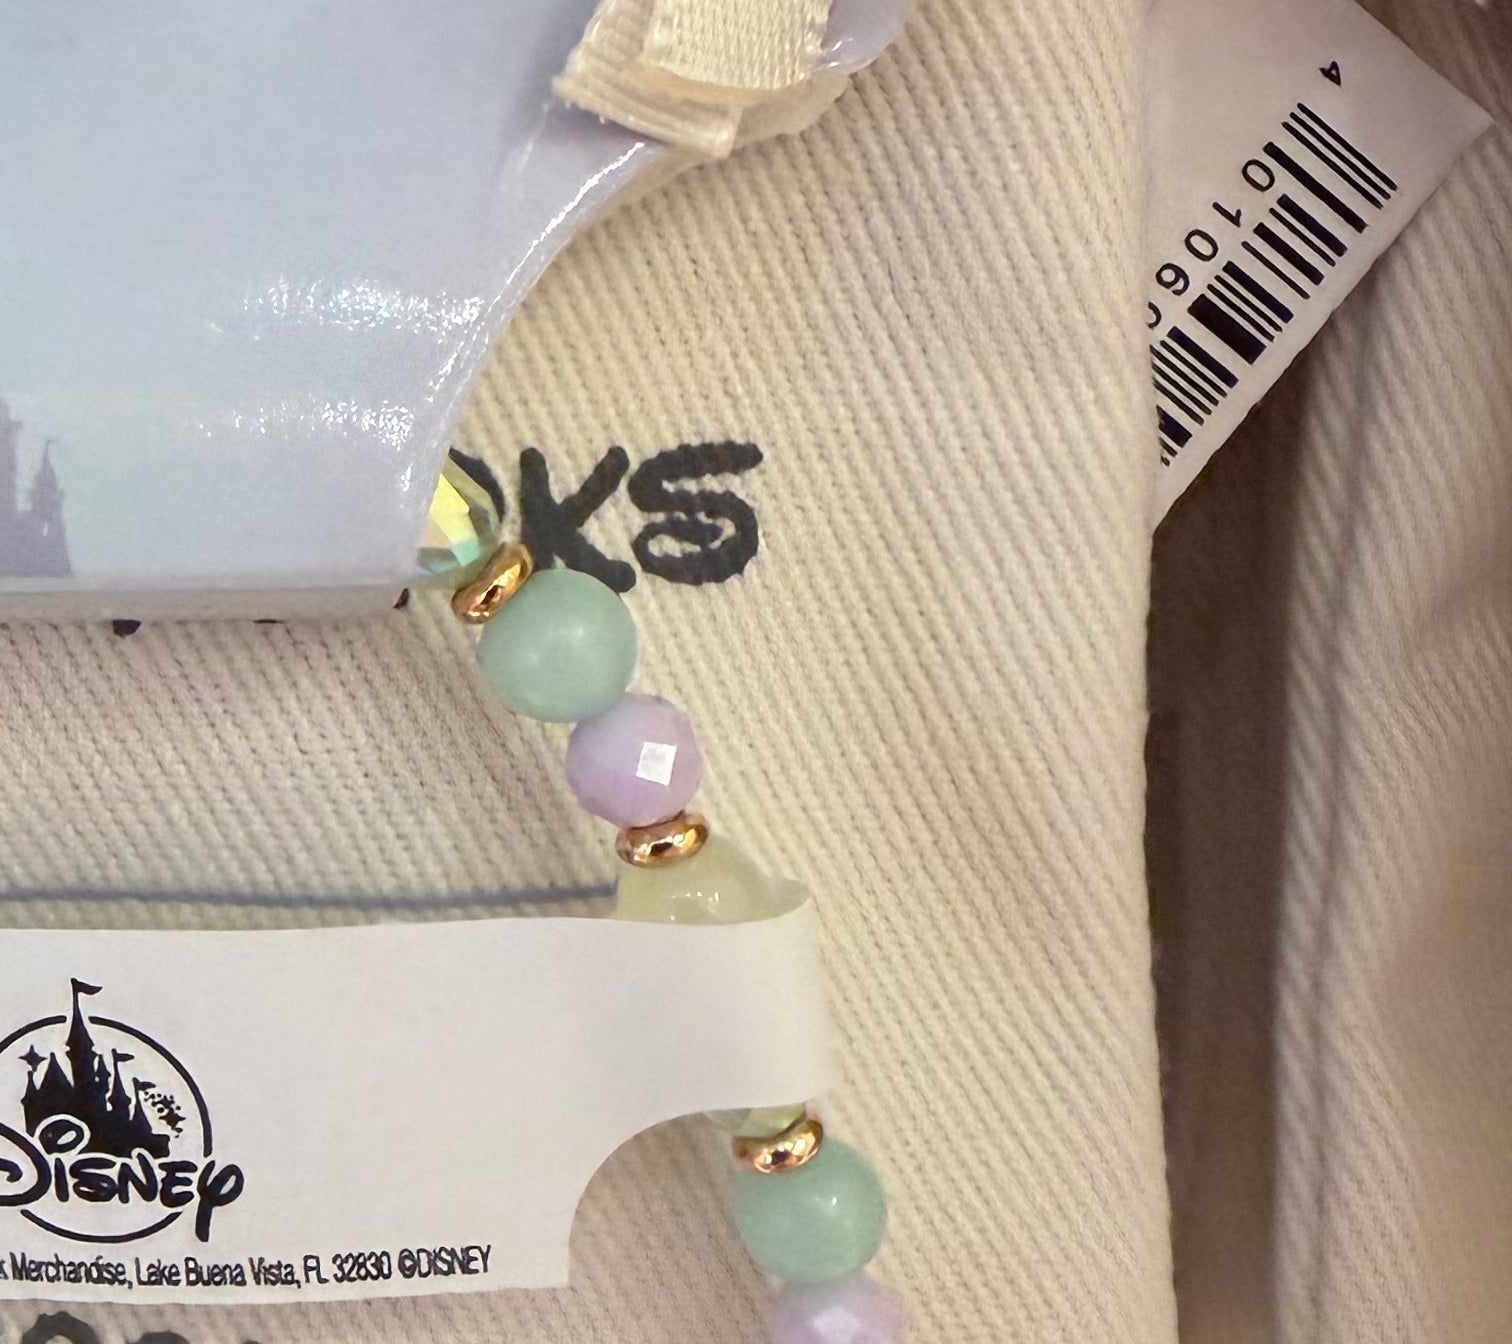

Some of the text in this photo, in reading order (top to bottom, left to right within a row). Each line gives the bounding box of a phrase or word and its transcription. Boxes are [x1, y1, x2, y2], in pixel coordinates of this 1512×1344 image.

[9, 1251, 133, 1290] Merchandise,
[134, 1256, 181, 1287] Lake
[184, 1256, 247, 1287] Buena
[248, 1255, 302, 1290] Vista,
[303, 1253, 331, 1284] FL
[331, 1249, 392, 1283] 32830
